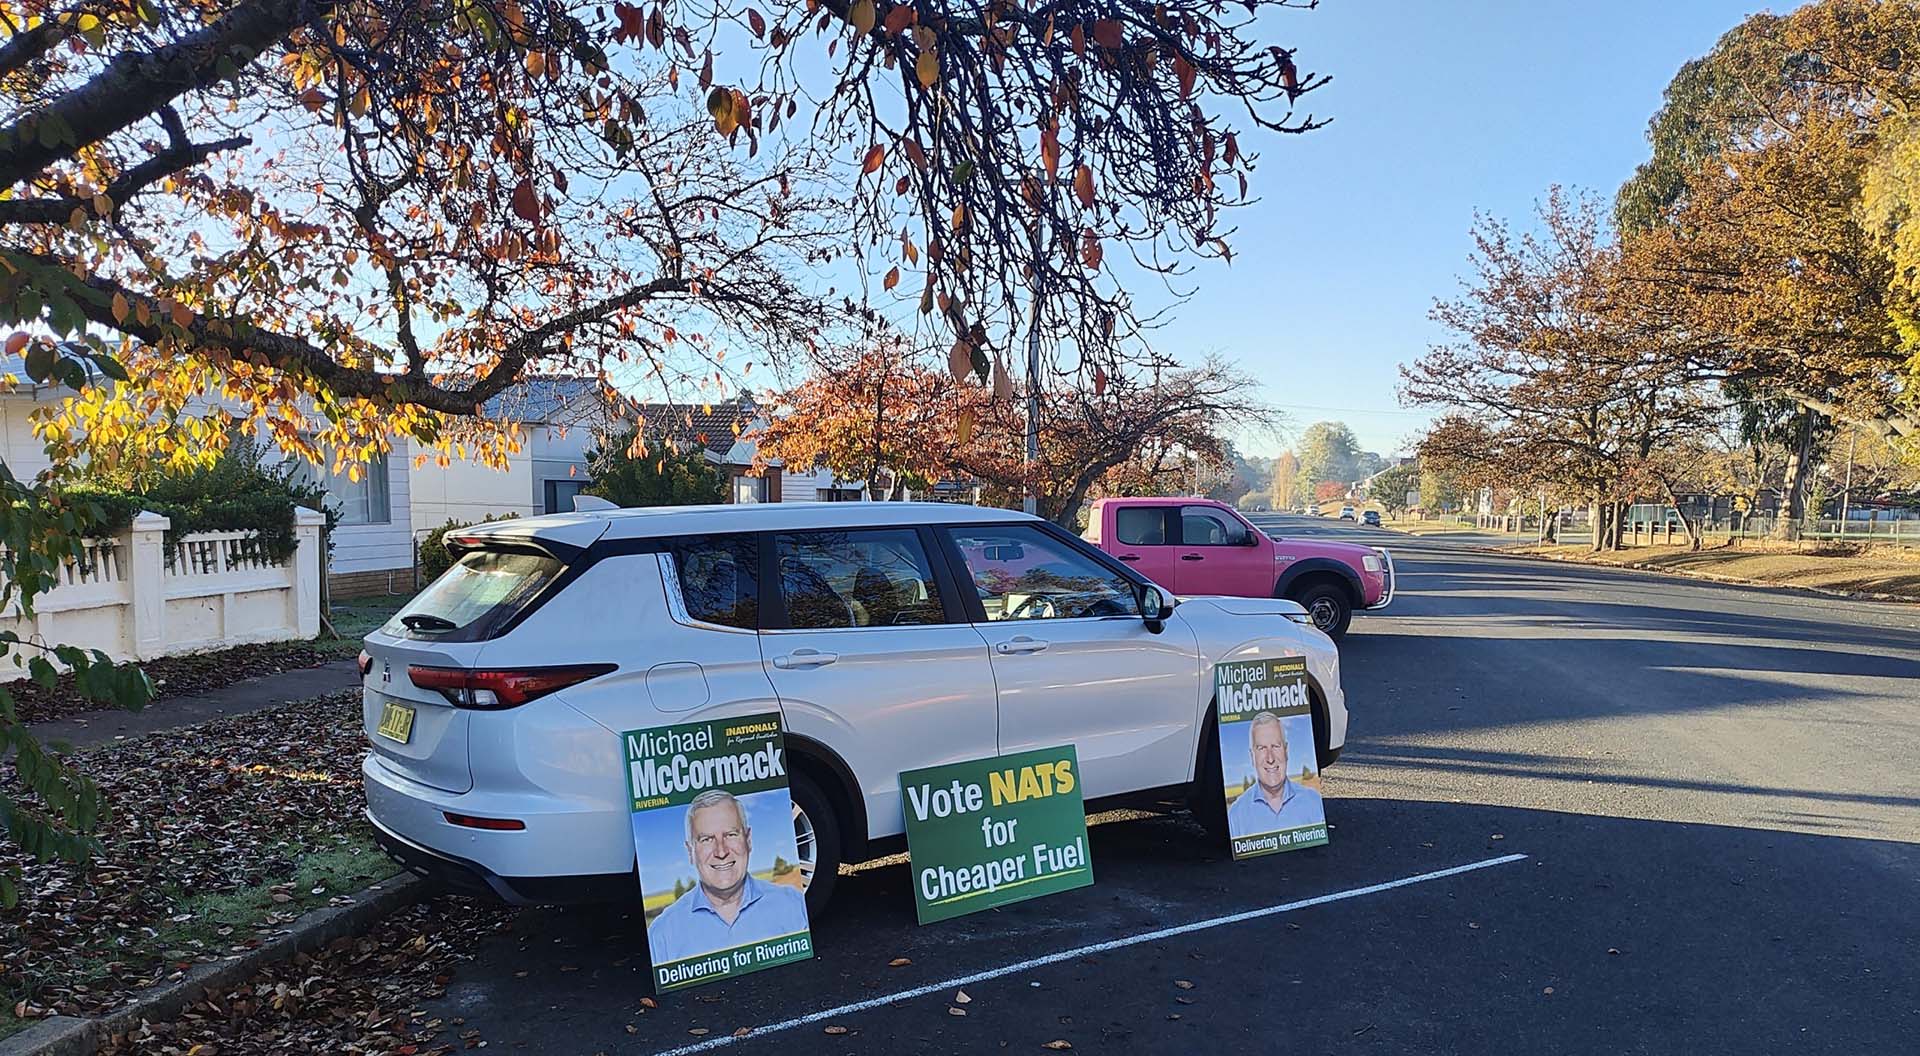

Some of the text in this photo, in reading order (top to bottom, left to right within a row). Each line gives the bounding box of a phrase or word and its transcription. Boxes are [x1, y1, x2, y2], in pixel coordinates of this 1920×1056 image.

[1218, 662, 1267, 685] Michael
[1218, 678, 1309, 714] McCormack
[628, 725, 714, 759] Michael
[729, 721, 778, 736] NATIONALS
[630, 741, 786, 799] McCormack
[635, 797, 670, 809] RIVERINA
[907, 759, 1076, 822] Vote NATS
[981, 816, 1018, 848] for
[1234, 835, 1278, 854] Delivering
[1278, 833, 1291, 846] for
[1292, 827, 1326, 843] Riverina
[920, 836, 1086, 901] Cheaper Fuel
[658, 955, 731, 985] Delivering
[732, 950, 753, 967] for
[755, 937, 810, 962] Riverina
